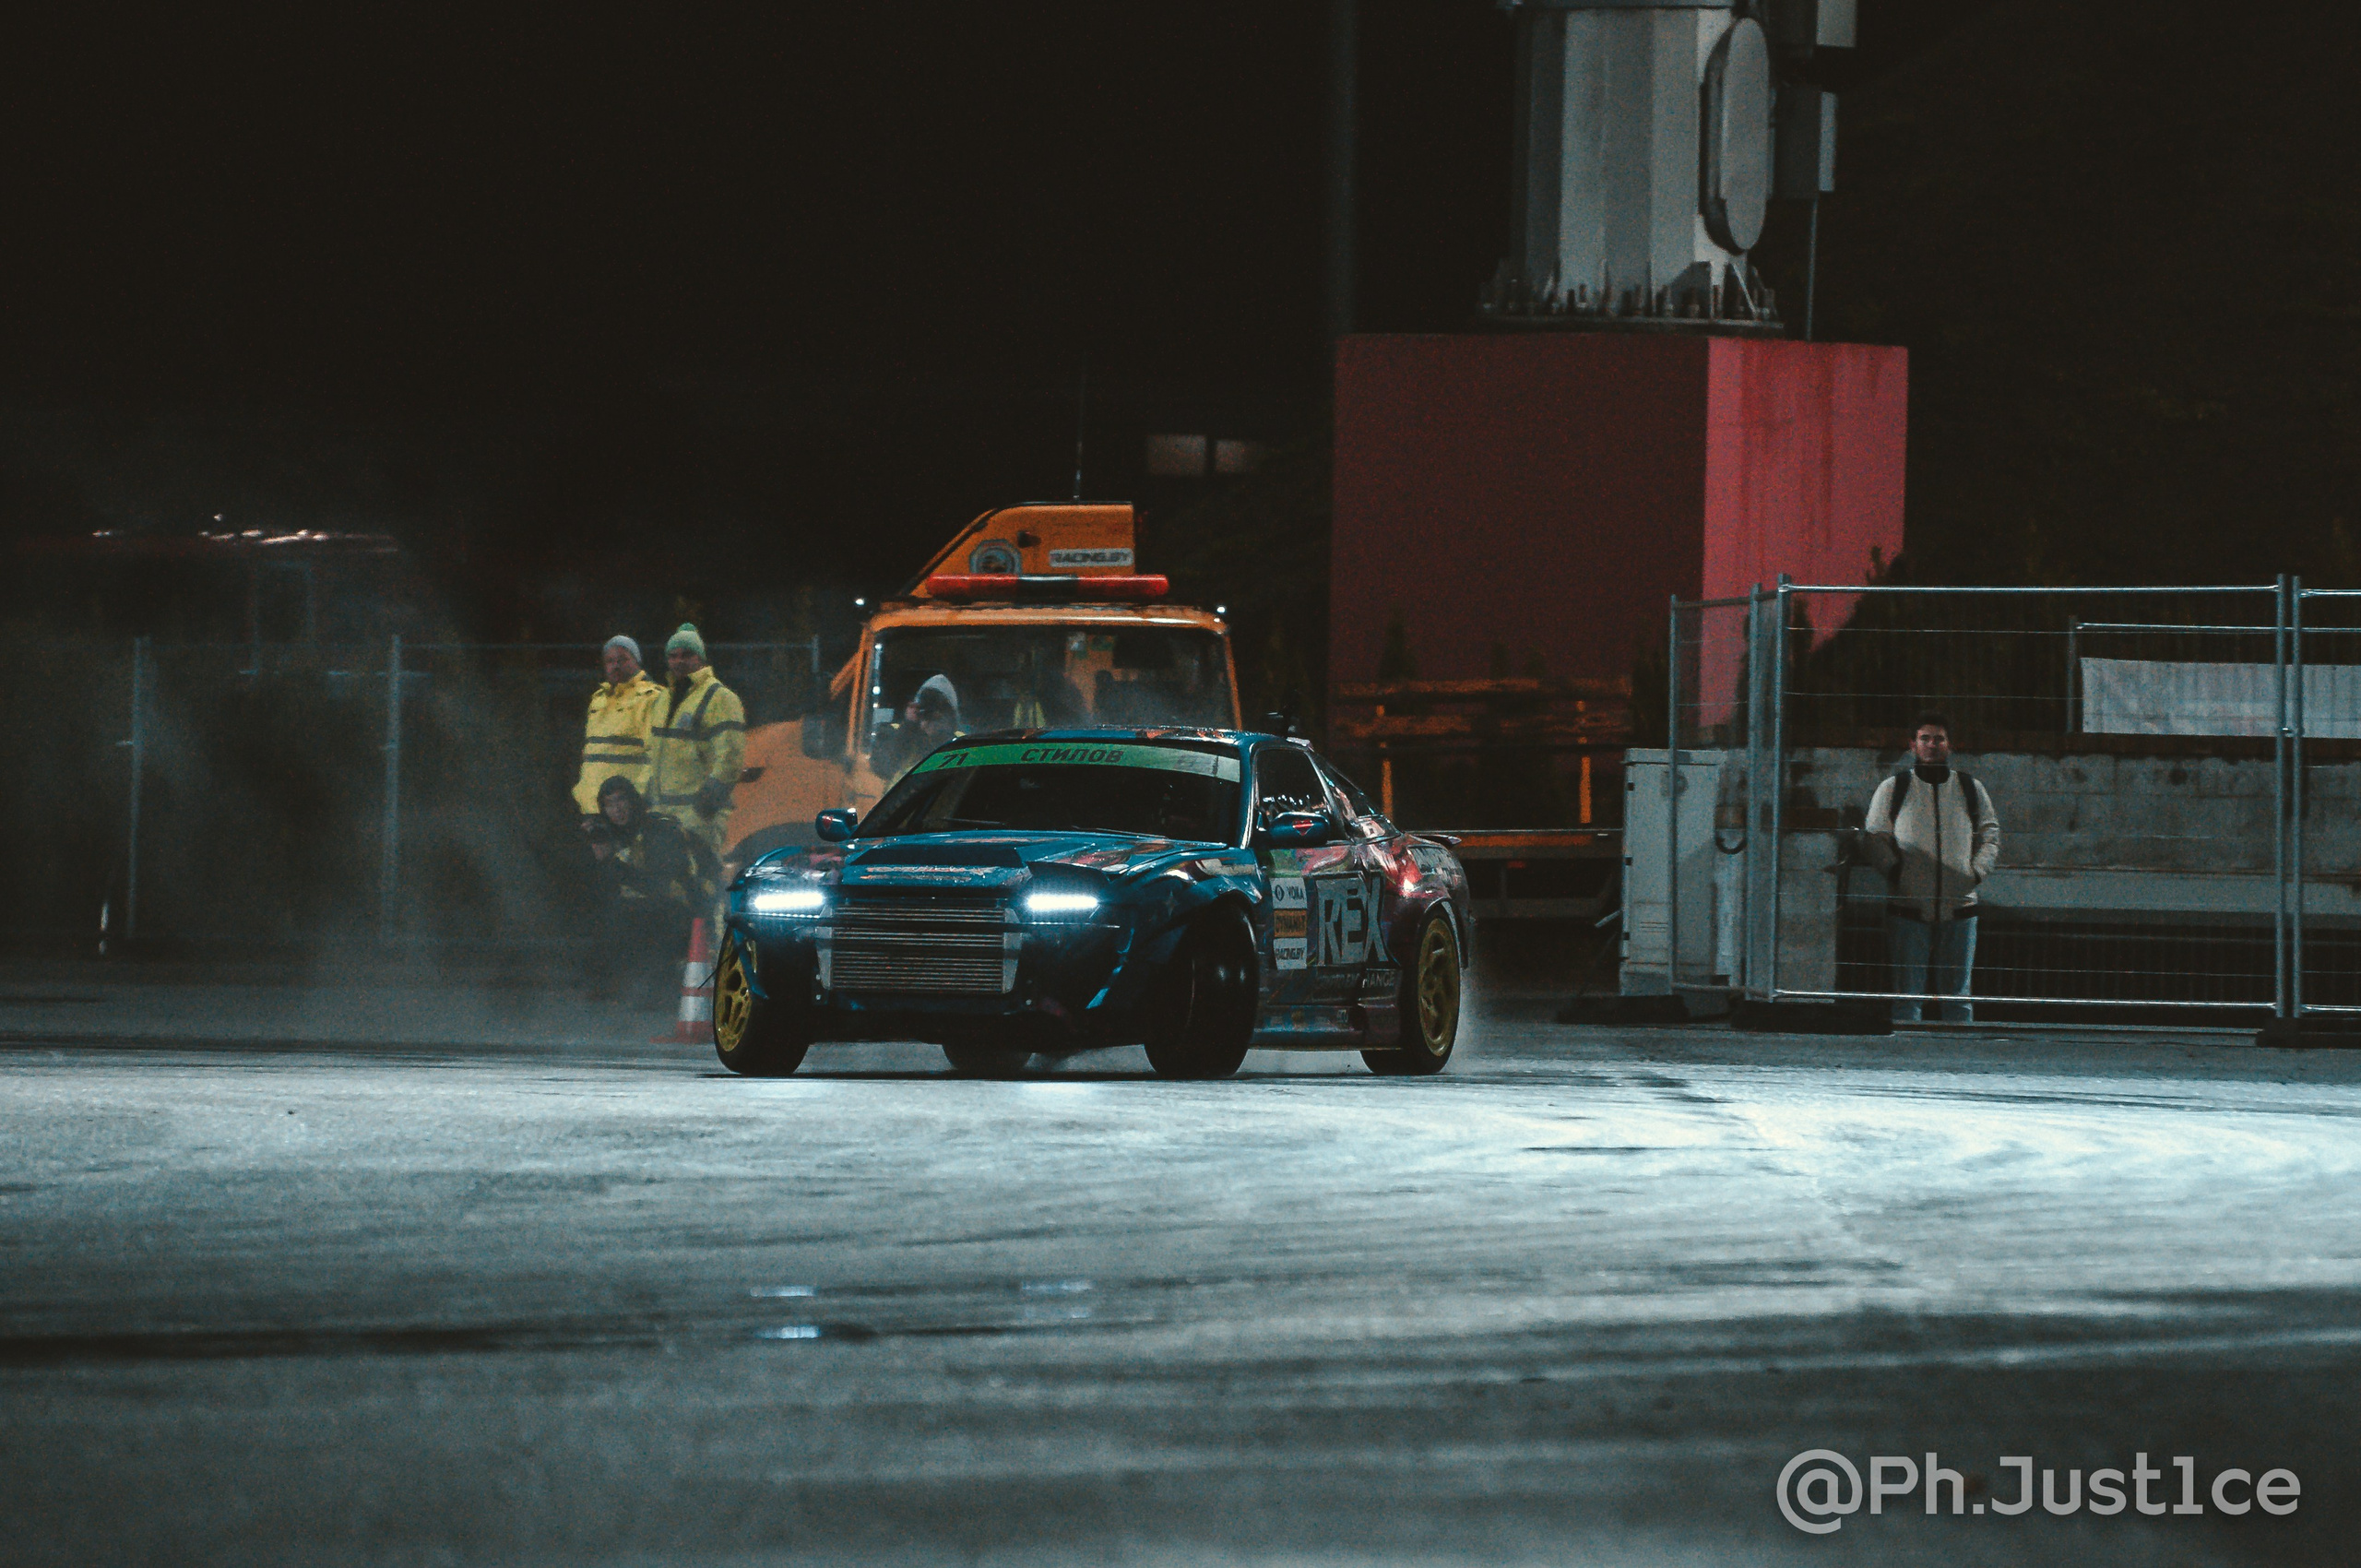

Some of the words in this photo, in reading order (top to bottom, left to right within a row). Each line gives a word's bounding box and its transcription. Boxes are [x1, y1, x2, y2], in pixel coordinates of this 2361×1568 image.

[939, 752, 968, 768] 71
[1020, 748, 1124, 763] СТИЛОВ
[1316, 877, 1389, 965] REX
